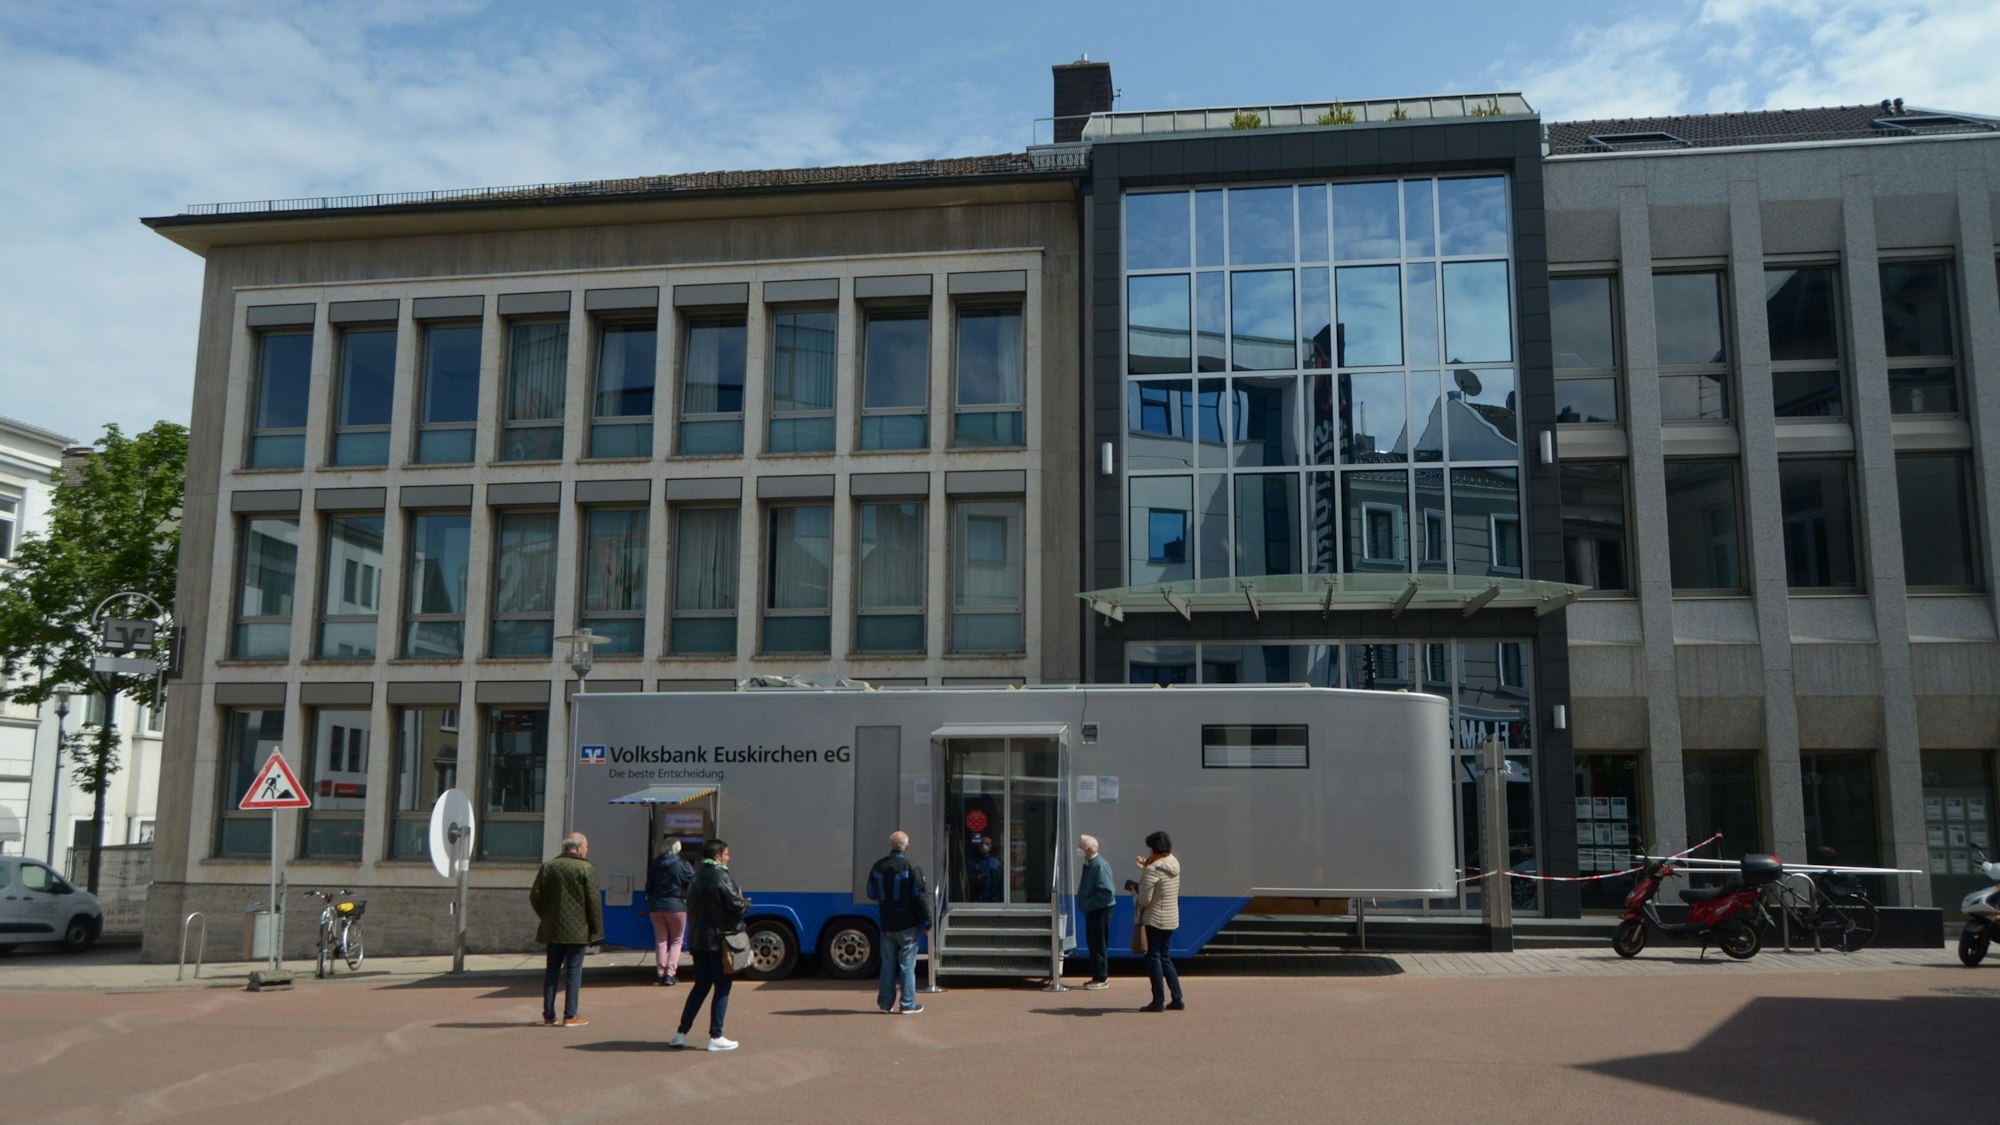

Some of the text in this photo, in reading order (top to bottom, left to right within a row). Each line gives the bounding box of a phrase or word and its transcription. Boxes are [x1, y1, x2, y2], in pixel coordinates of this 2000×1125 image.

[610, 745, 851, 763] Volksbank Euskirchen eG
[609, 768, 727, 781] Die beste Entscheidung.
